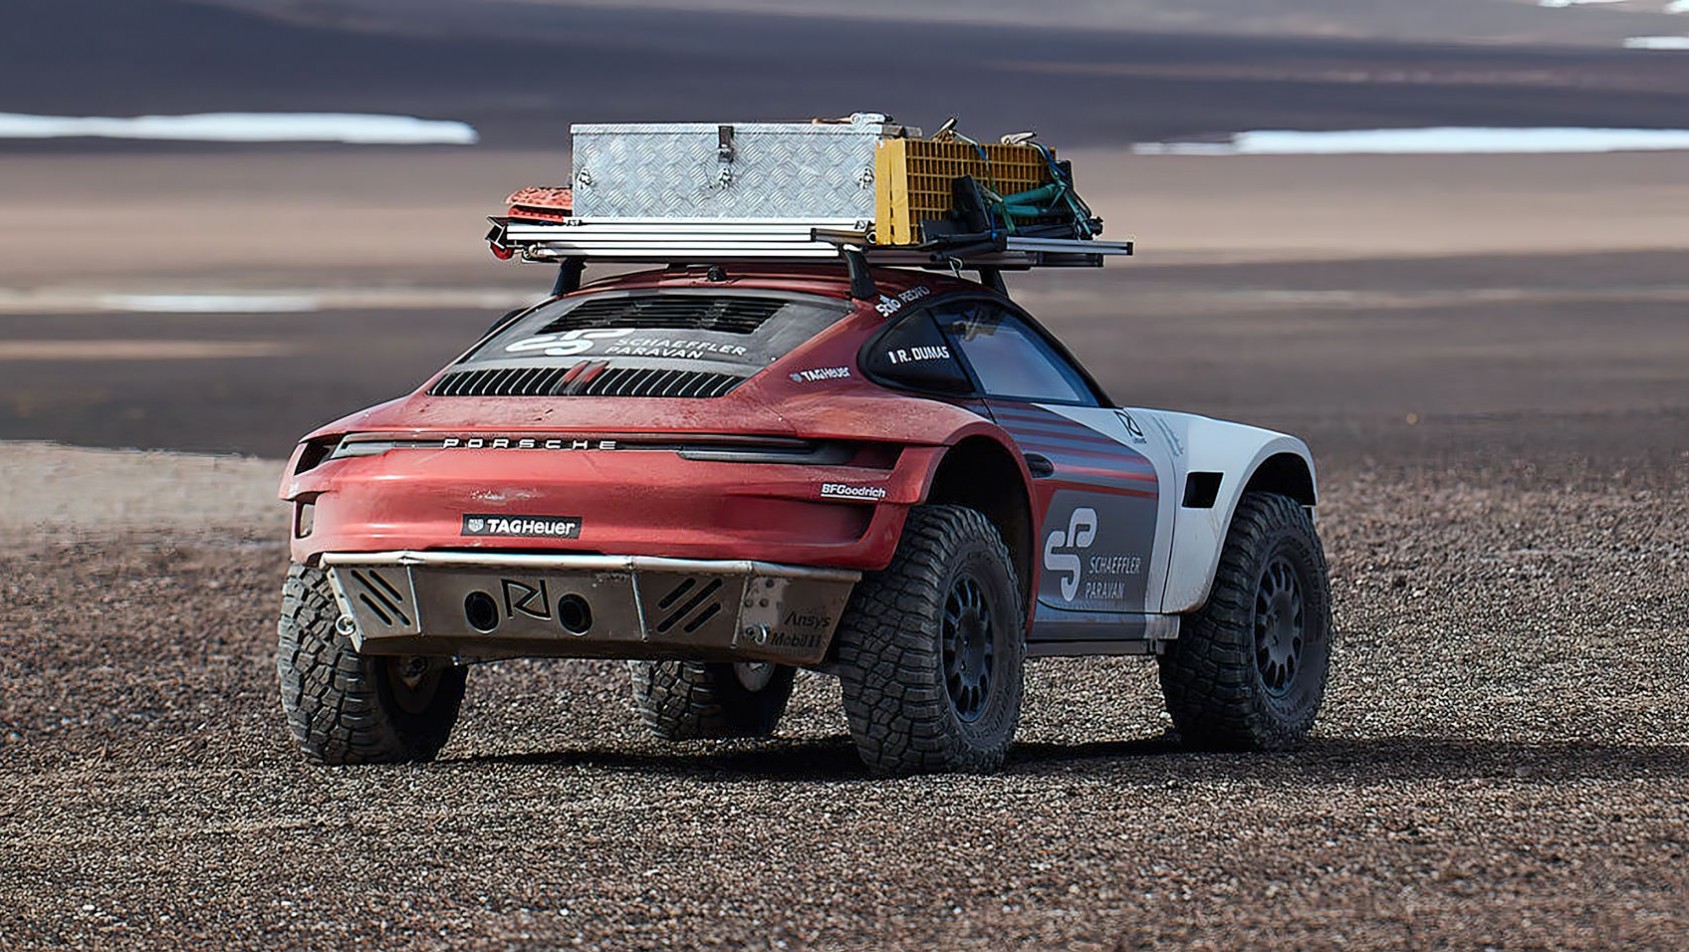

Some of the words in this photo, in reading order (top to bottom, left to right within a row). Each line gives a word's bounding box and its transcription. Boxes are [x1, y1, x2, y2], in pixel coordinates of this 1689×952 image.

[604, 346, 703, 360] PARAVAN
[616, 338, 747, 356] SCHAEFFLER
[911, 346, 950, 361] DUMAS
[442, 438, 616, 450] PORSCHE
[821, 483, 886, 499] BFGoodrich
[1089, 556, 1142, 574] SCHAEFFLER
[1085, 581, 1125, 600] PARAVAN
[784, 610, 832, 630] Ansys
